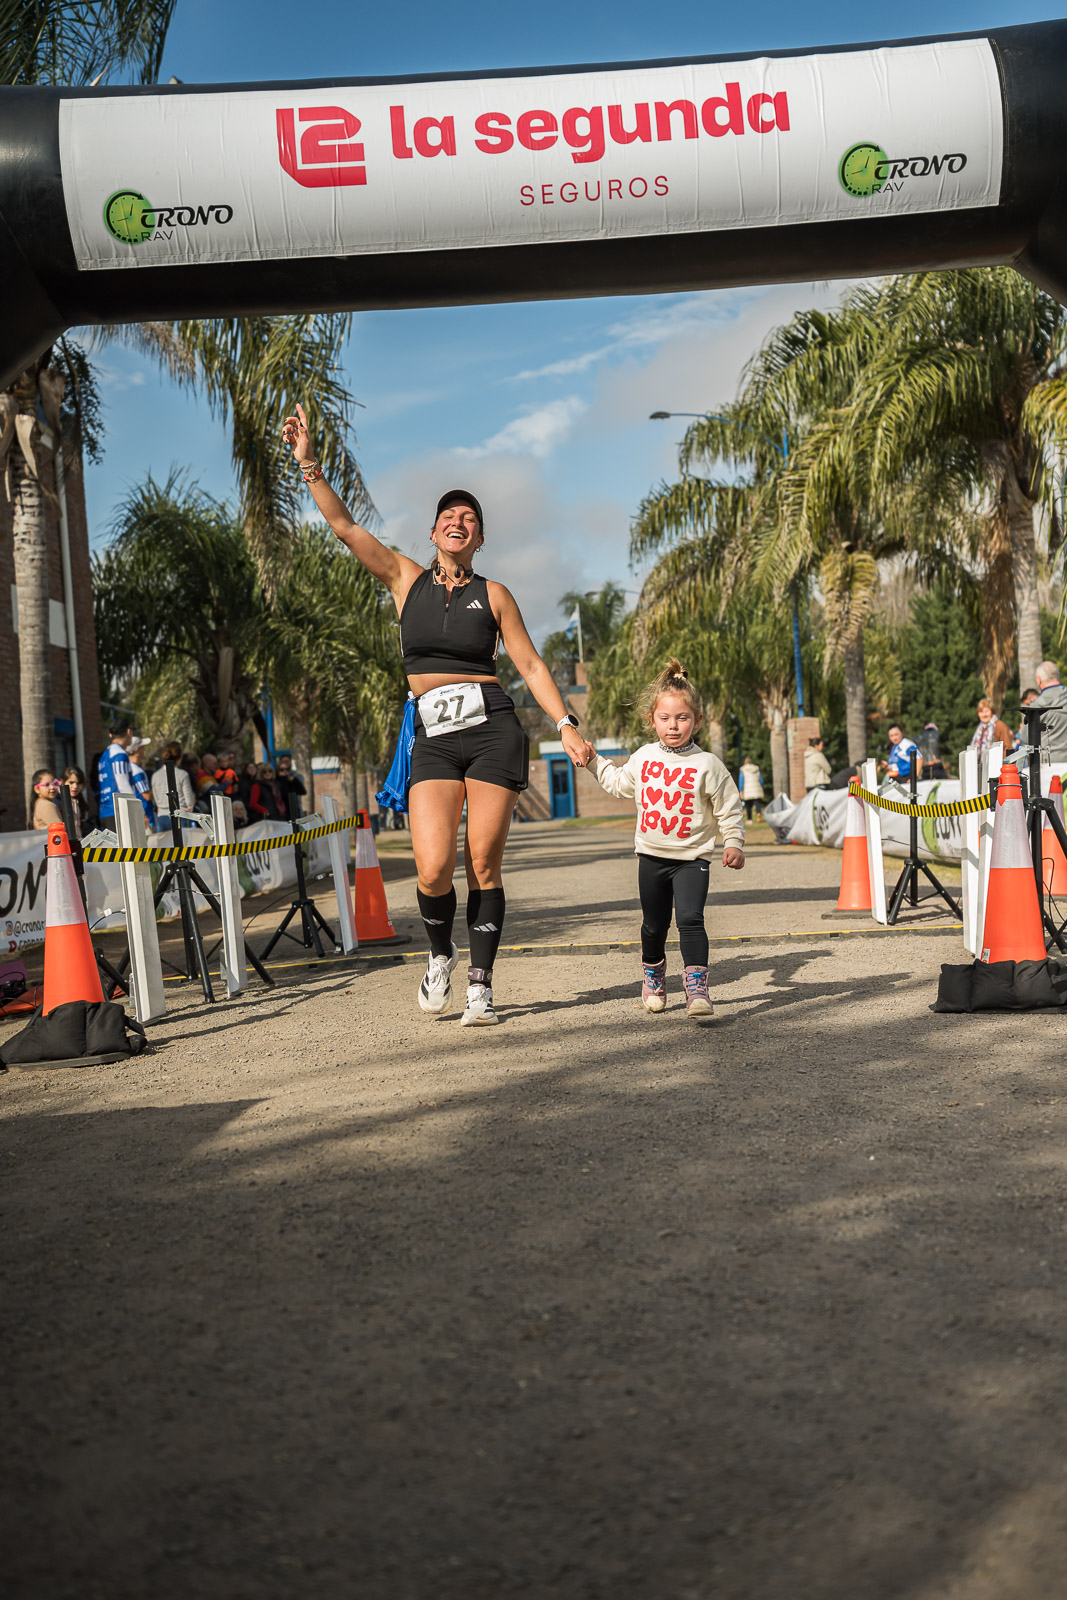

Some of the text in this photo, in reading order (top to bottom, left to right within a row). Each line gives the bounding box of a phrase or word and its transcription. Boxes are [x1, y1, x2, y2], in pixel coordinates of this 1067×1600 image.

[389, 81, 791, 164] la segunda
[874, 153, 967, 180] CRONO
[520, 175, 670, 207] SEGUROS
[871, 182, 904, 195] RAV
[140, 204, 234, 228] CRONO
[140, 230, 174, 242] RAV
[433, 694, 465, 724] 27
[641, 760, 698, 790] LOVE
[640, 810, 692, 839] LOVE
